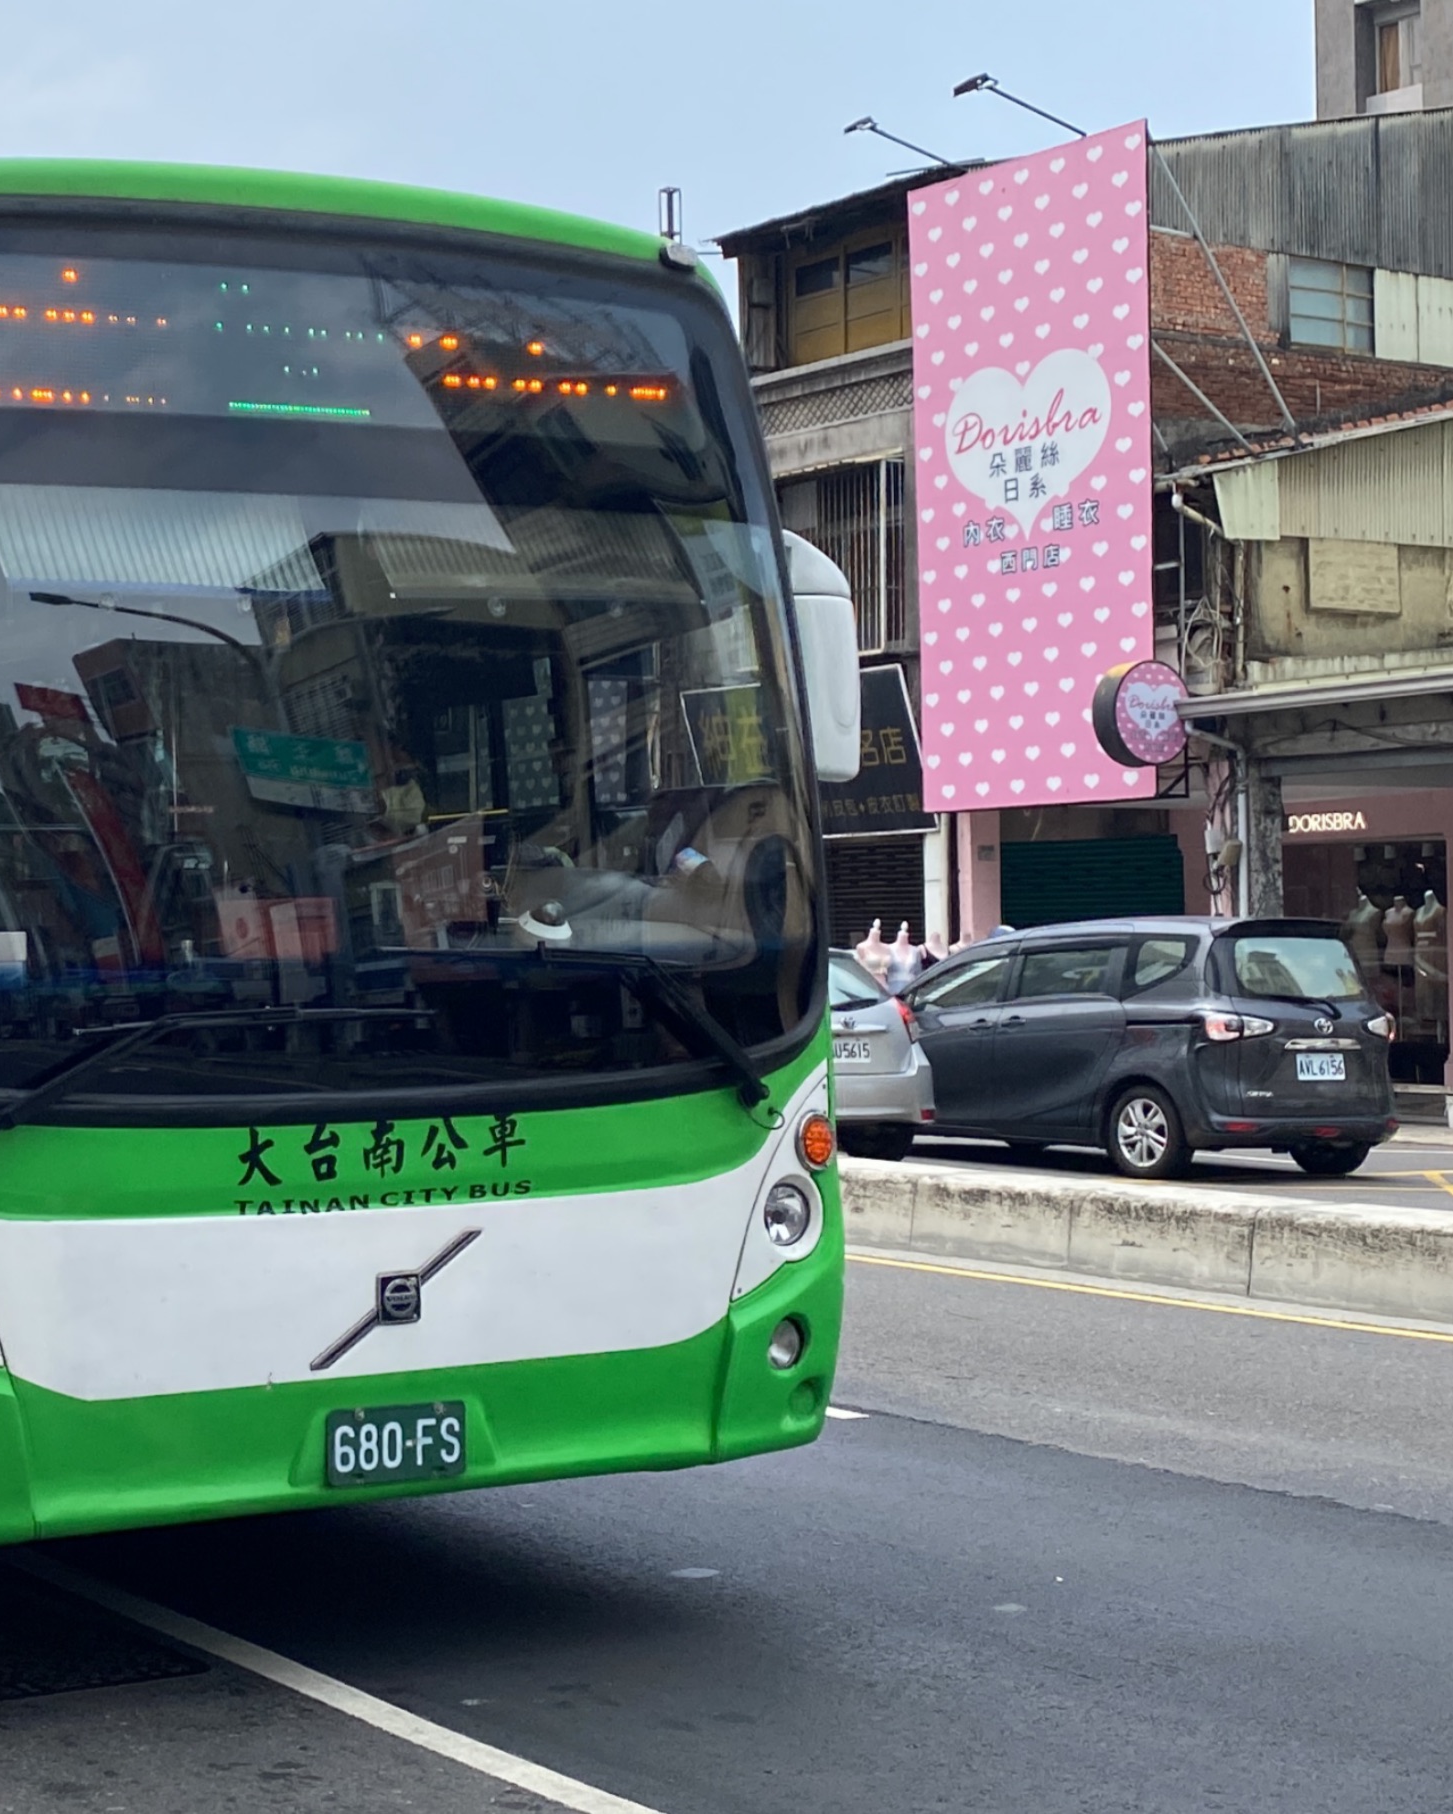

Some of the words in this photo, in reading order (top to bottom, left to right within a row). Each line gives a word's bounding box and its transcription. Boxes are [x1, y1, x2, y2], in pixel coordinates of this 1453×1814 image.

[952, 388, 1102, 454] Dorisbra
[989, 441, 1060, 478] 朵麗絲
[1004, 473, 1047, 503] 日系
[963, 516, 1005, 547] 內衣
[1053, 499, 1100, 531] 睡衣
[1001, 543, 1060, 574] 西門店
[1288, 811, 1366, 833] DORISBRA
[237, 1115, 526, 1187] 大台南公車
[234, 1194, 371, 1216] TAINAN
[380, 1185, 459, 1207] CITY
[469, 1179, 532, 1199] BUS
[334, 1416, 462, 1474] 680-FS
